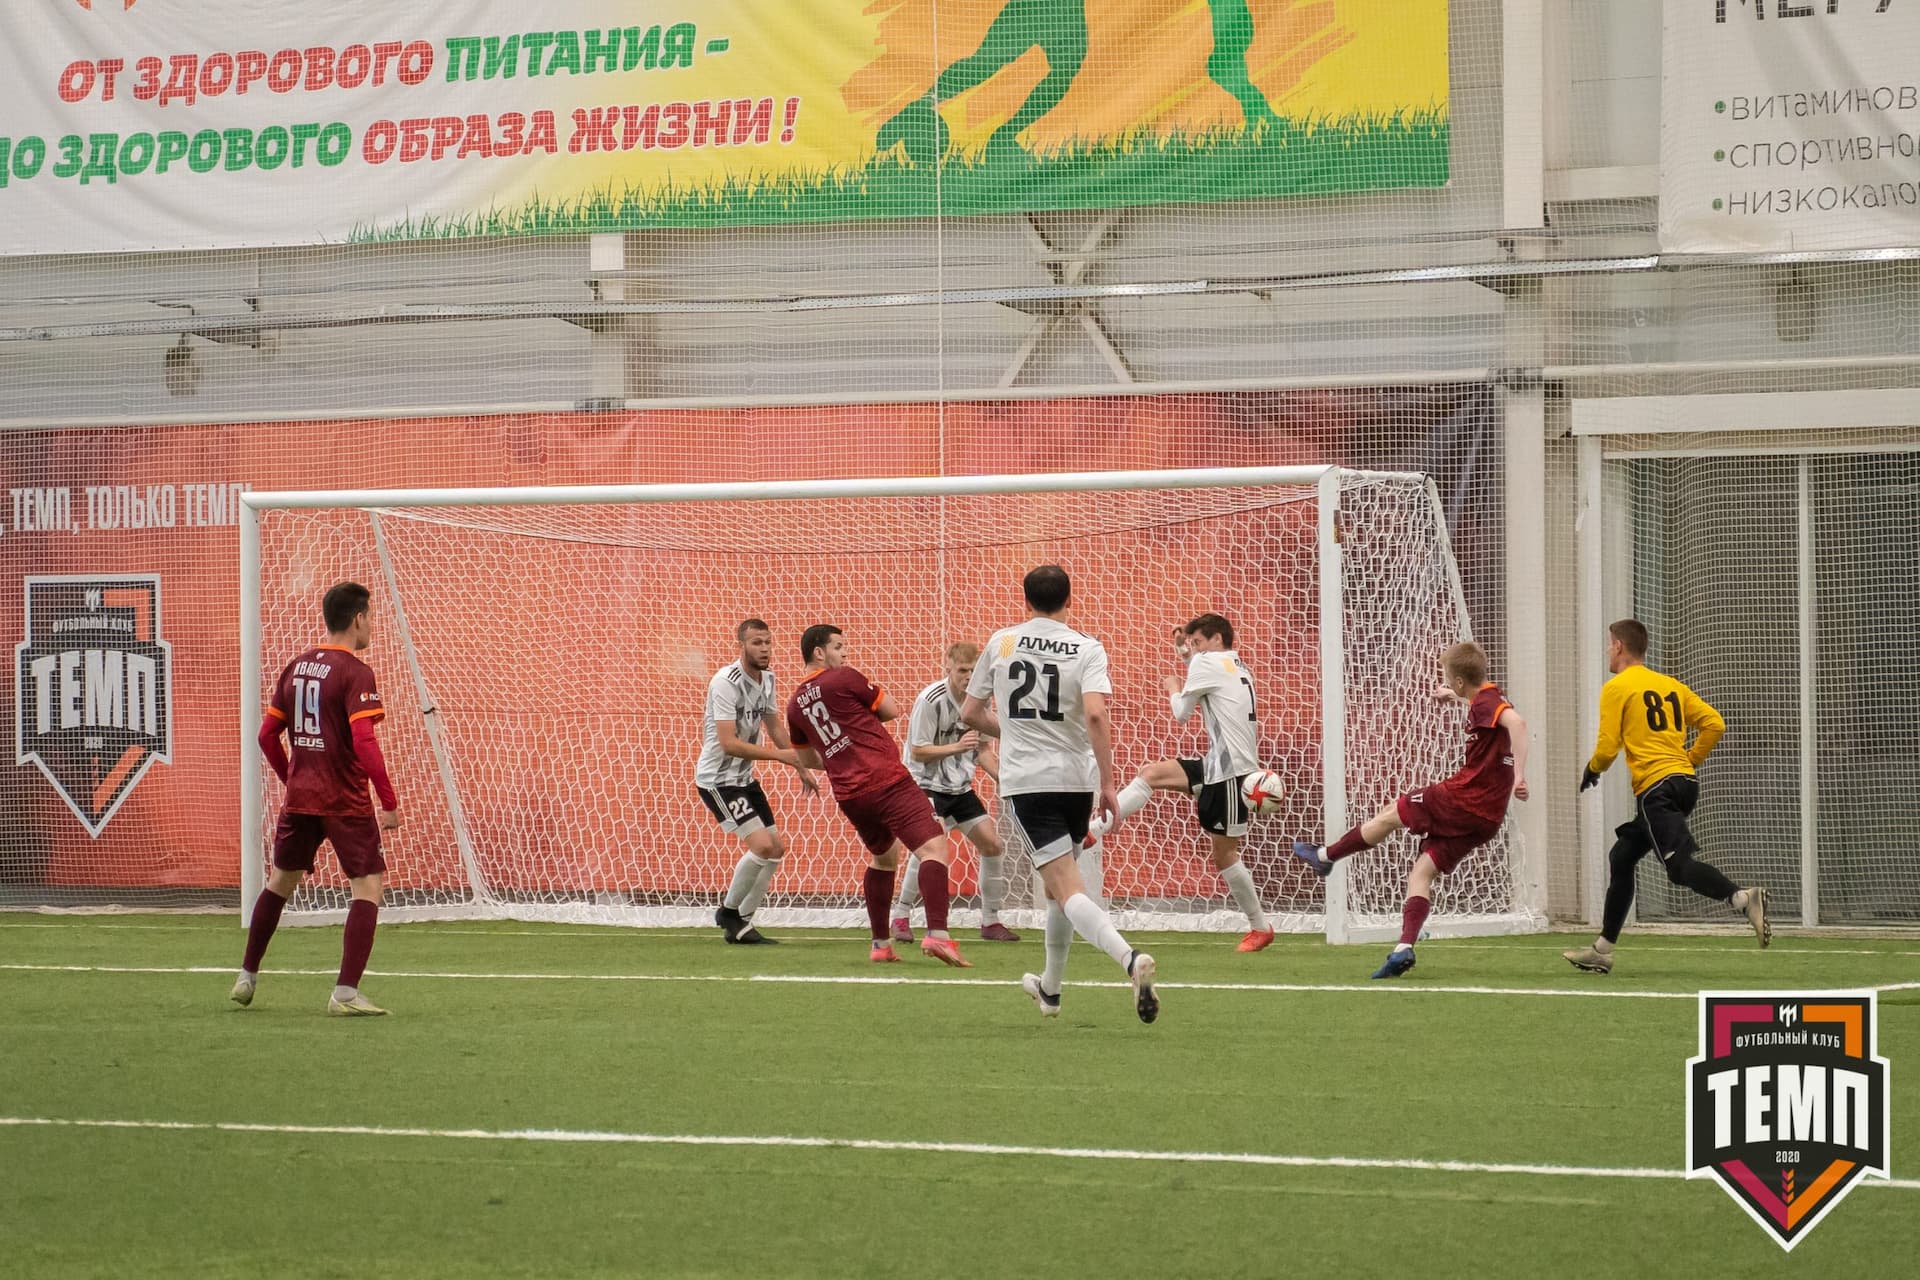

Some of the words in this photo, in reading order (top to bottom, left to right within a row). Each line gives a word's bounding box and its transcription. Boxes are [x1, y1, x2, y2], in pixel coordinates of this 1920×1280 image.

[57, 58, 124, 103] ОТ
[132, 40, 434, 107] ЗДОРОВОГО
[445, 22, 697, 83] ПИТАНИЯ
[53, 122, 352, 185] ЗДОРОВОГО
[362, 109, 559, 165] ОБРАЗА
[567, 97, 773, 153] ЖИЗНИ
[1730, 133, 1920, 170] спортивно
[1728, 183, 1920, 215] низкокало
[10, 487, 79, 535] ТЕМП,
[86, 484, 176, 529] ТОЛЬКО
[1018, 636, 1080, 655] АЛМАЗ
[31, 649, 156, 736] ТЕМП
[293, 678, 321, 735] 19
[1009, 660, 1064, 721] 21
[1643, 690, 1683, 732] 81
[802, 701, 841, 746] 13
[728, 796, 754, 820] 22
